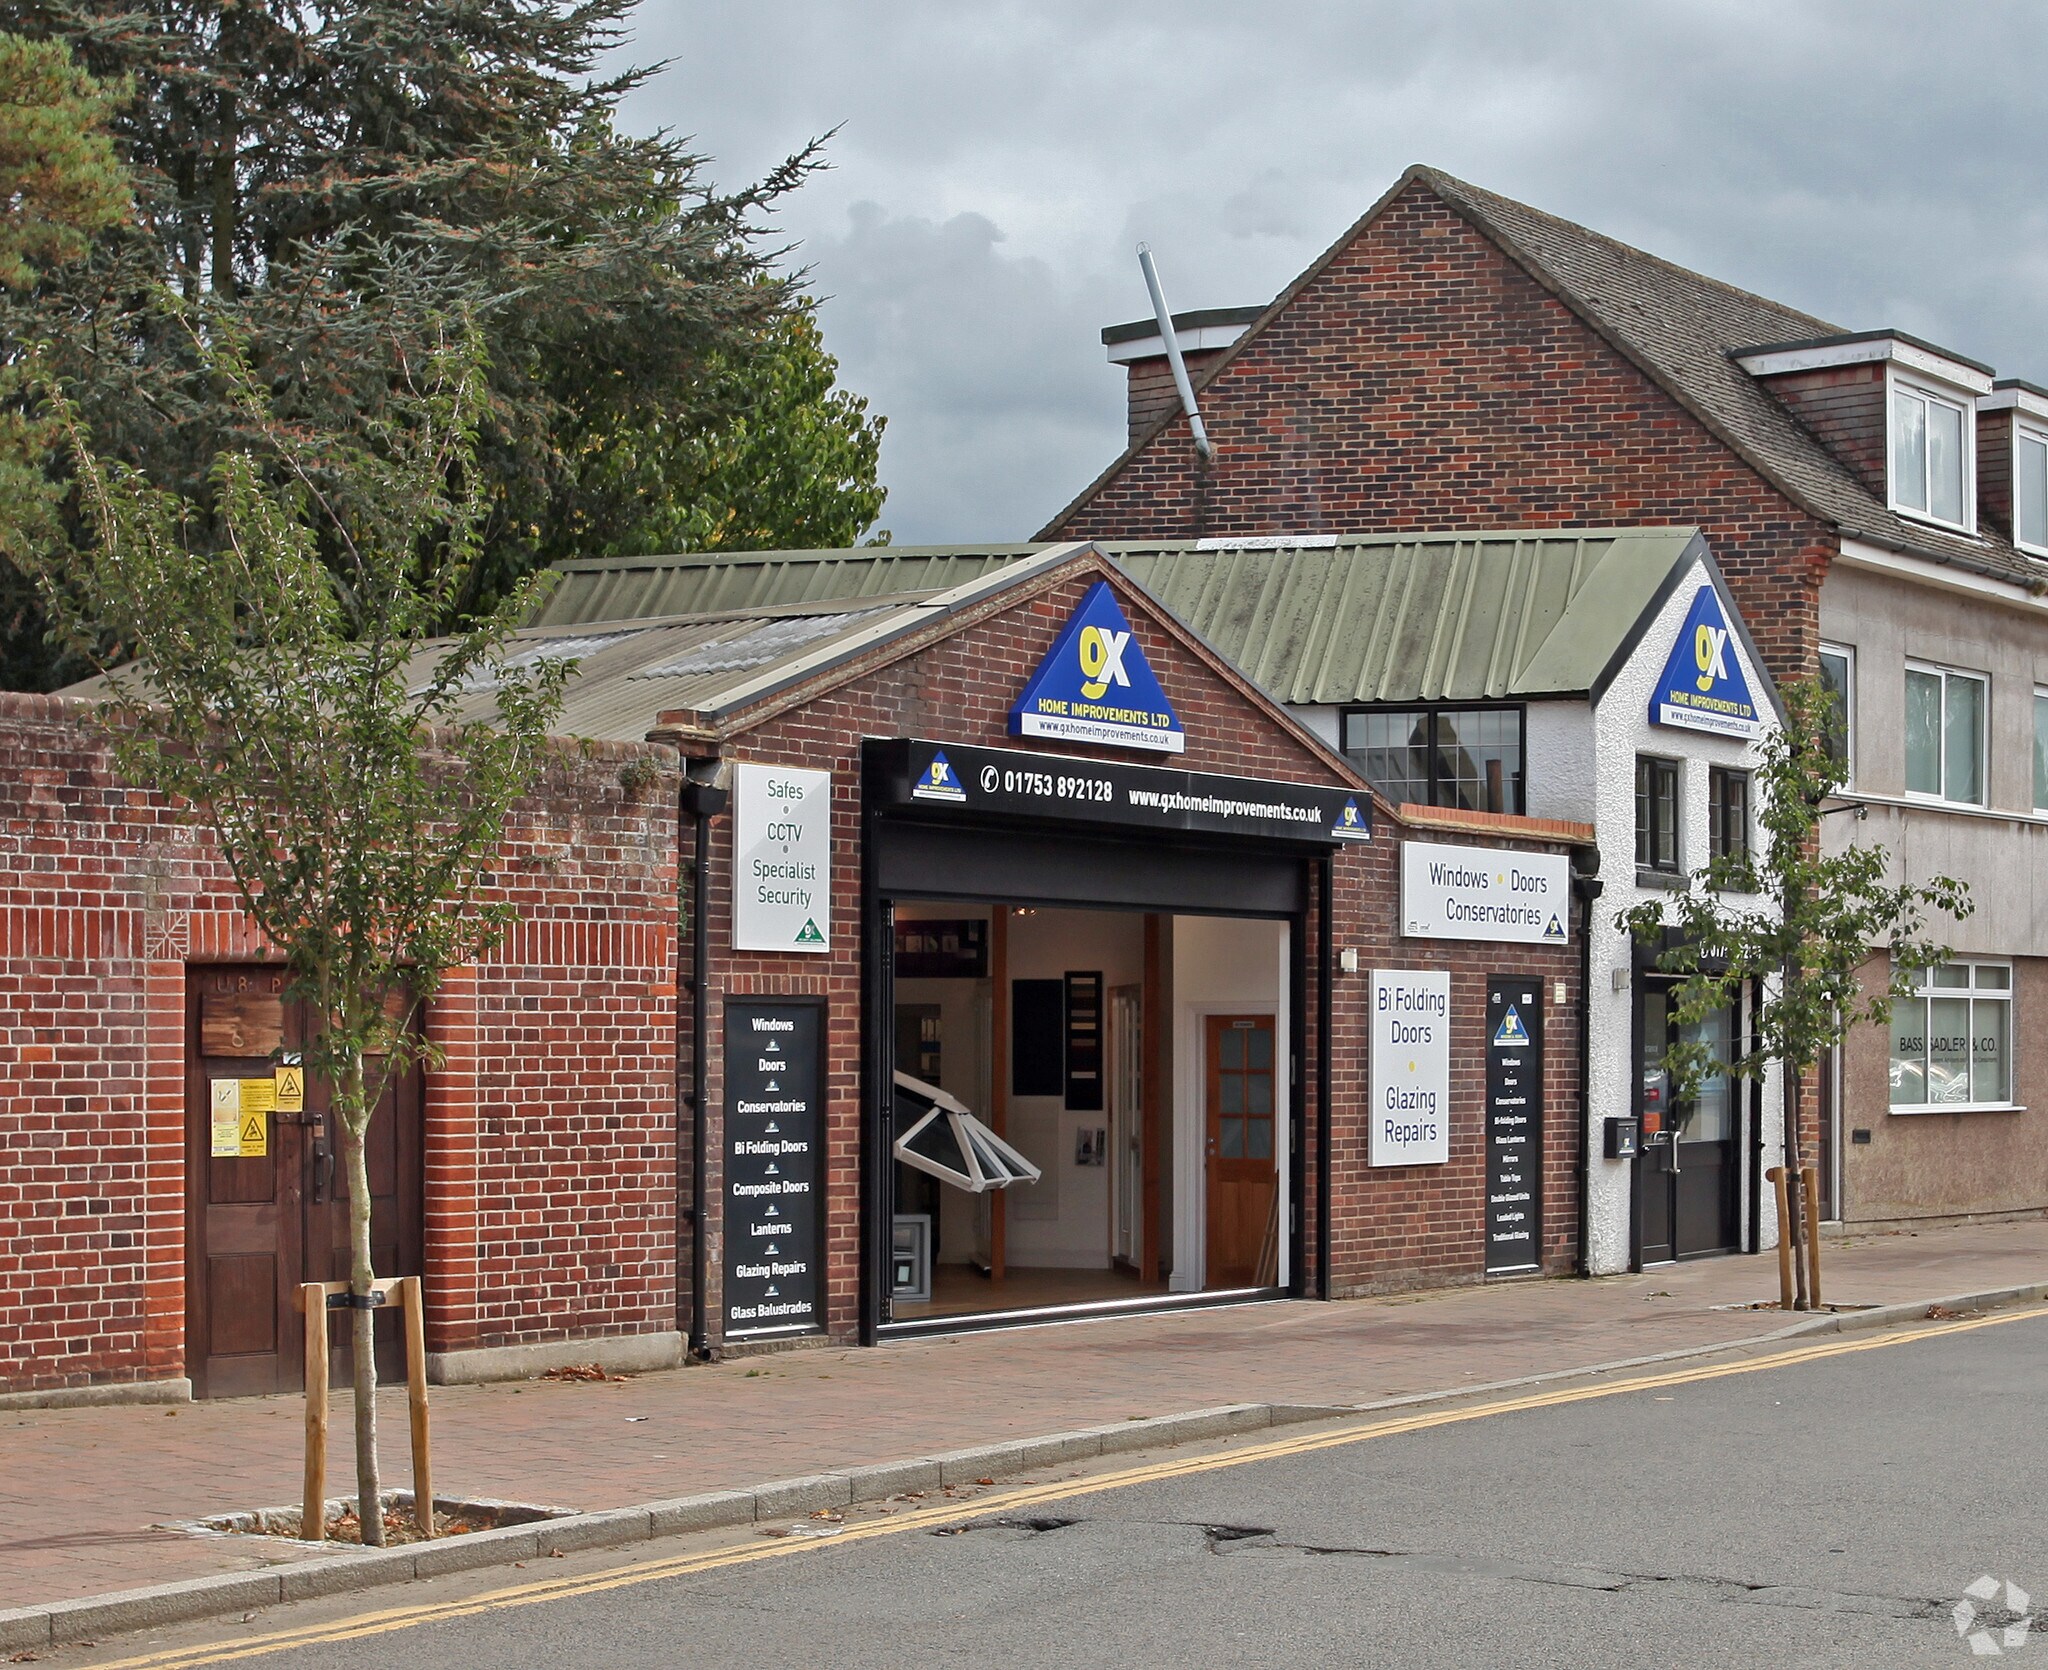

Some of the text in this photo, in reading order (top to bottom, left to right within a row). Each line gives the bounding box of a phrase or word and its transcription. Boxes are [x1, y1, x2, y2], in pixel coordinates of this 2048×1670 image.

[1079, 625, 1131, 700] gx
[1695, 624, 1728, 692] gx
[1038, 698, 1170, 728] HOME IMPROVEMENTS LTD
[1670, 690, 1752, 717] HOME IMPROVEMENTS LTD
[1038, 720, 1169, 745] www.gxhomeimprovements.co.uk
[767, 779, 803, 800] Safes
[1004, 770, 1322, 823] 01753 892128 www.gxhomeimprovements.co.uk
[767, 823, 802, 842] CCTV
[753, 859, 816, 882] Specialist
[1429, 862, 1547, 893] Windows Doors
[757, 885, 812, 910] Security
[1446, 897, 1541, 925] Conservatories
[1378, 987, 1445, 1017] Bi Folding
[752, 1018, 794, 1032] Windows
[1391, 1020, 1432, 1044] Doors
[1900, 1037, 1923, 1052] BASS
[1981, 1037, 1997, 1052] CO.
[758, 1058, 786, 1072] Doors
[737, 1099, 806, 1114] Conservatories
[1386, 1086, 1436, 1115] Glazing
[1385, 1118, 1437, 1148] Repairs
[735, 1141, 808, 1157] Bi Folding Doors
[733, 1181, 809, 1198] Composite Doors
[751, 1222, 792, 1236] Lanterns
[736, 1261, 806, 1279] Glazing Repairs
[731, 1301, 811, 1319] Glass Balustrades
